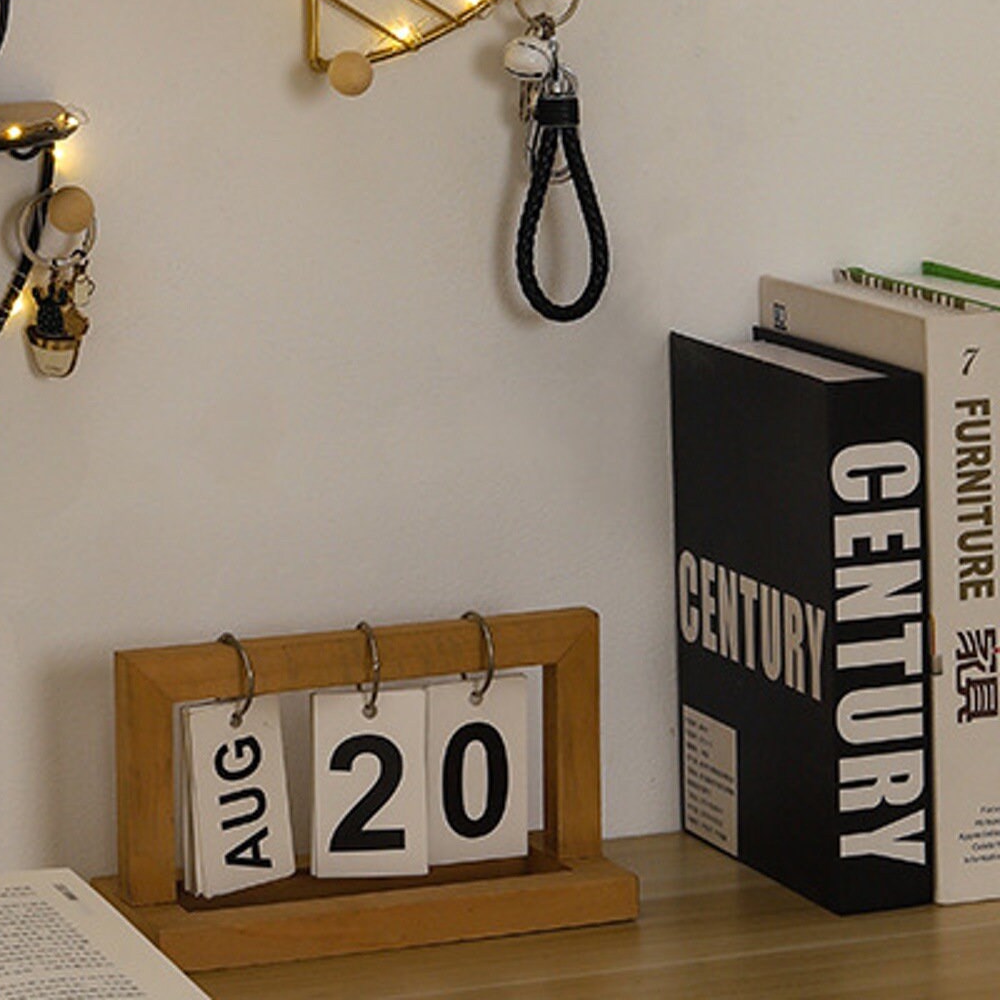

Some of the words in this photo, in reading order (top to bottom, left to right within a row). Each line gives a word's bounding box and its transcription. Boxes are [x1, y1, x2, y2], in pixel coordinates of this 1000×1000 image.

[962, 347, 980, 375] 7
[955, 398, 995, 601] FURNITURE
[678, 550, 826, 701] CENTURY
[831, 441, 926, 866] CENTURY
[214, 735, 273, 869] AUG
